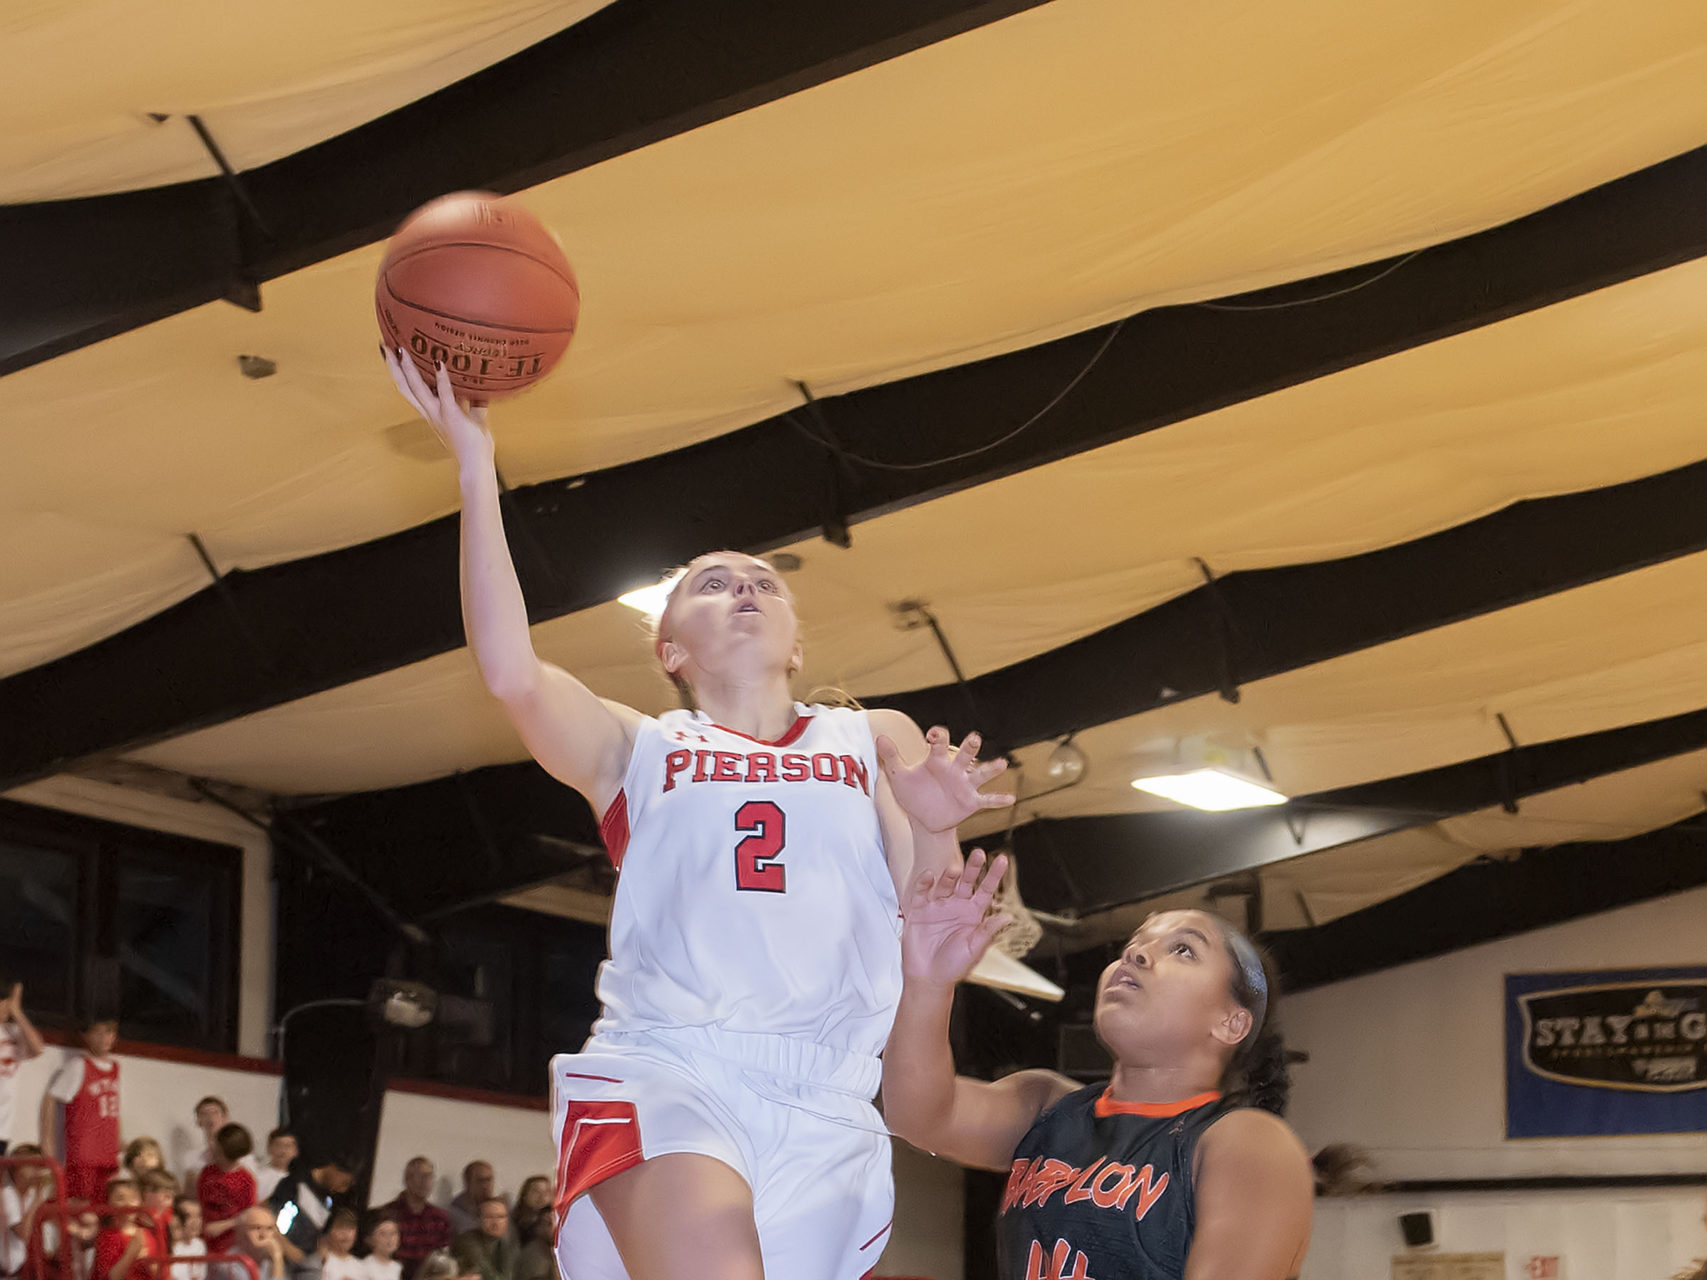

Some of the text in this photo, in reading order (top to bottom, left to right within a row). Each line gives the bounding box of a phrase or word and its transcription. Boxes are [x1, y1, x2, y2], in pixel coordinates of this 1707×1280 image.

[411, 334, 545, 379] TF-1000
[662, 748, 871, 797] PIERSON
[734, 800, 787, 893] 2
[1536, 1016, 1632, 1047] STAY
